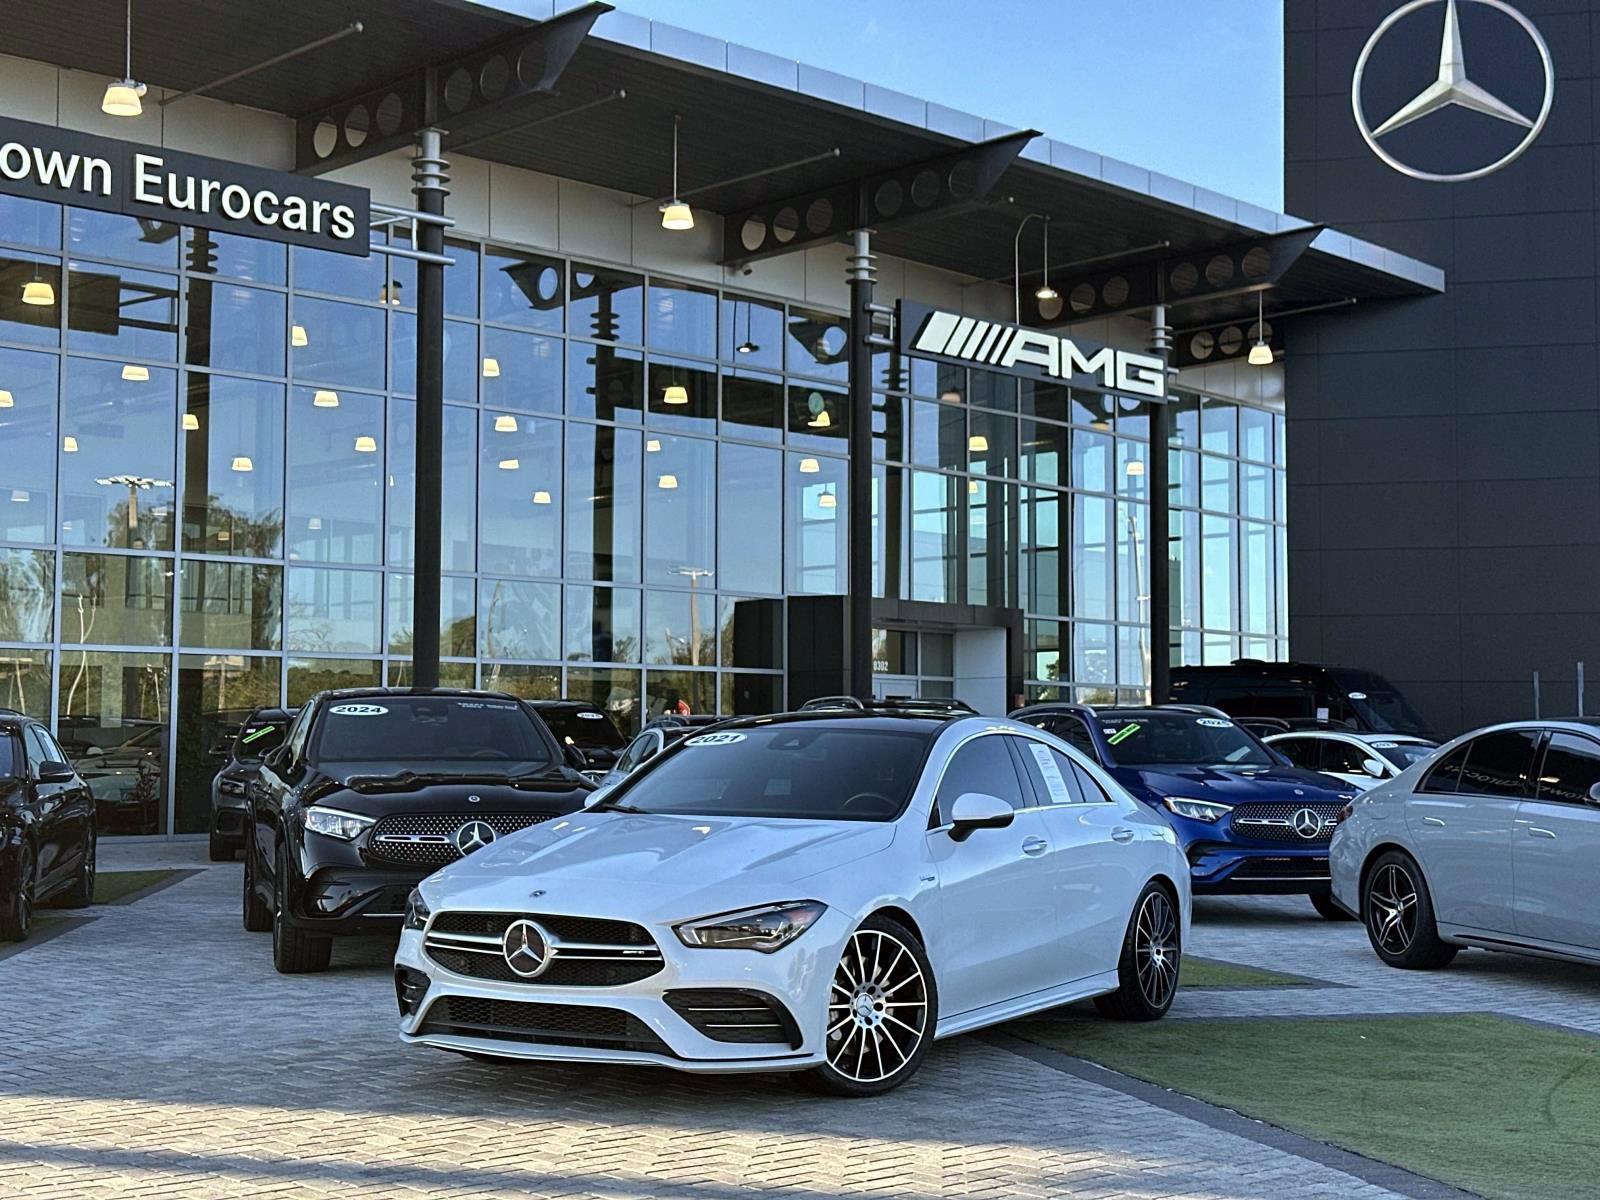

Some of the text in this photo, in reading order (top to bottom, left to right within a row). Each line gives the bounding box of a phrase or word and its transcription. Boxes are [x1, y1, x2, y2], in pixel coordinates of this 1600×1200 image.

[0, 142, 356, 239] own Eurocars
[1001, 328, 1164, 397] AMG
[335, 706, 382, 714] 2024
[690, 734, 741, 744] 2021
